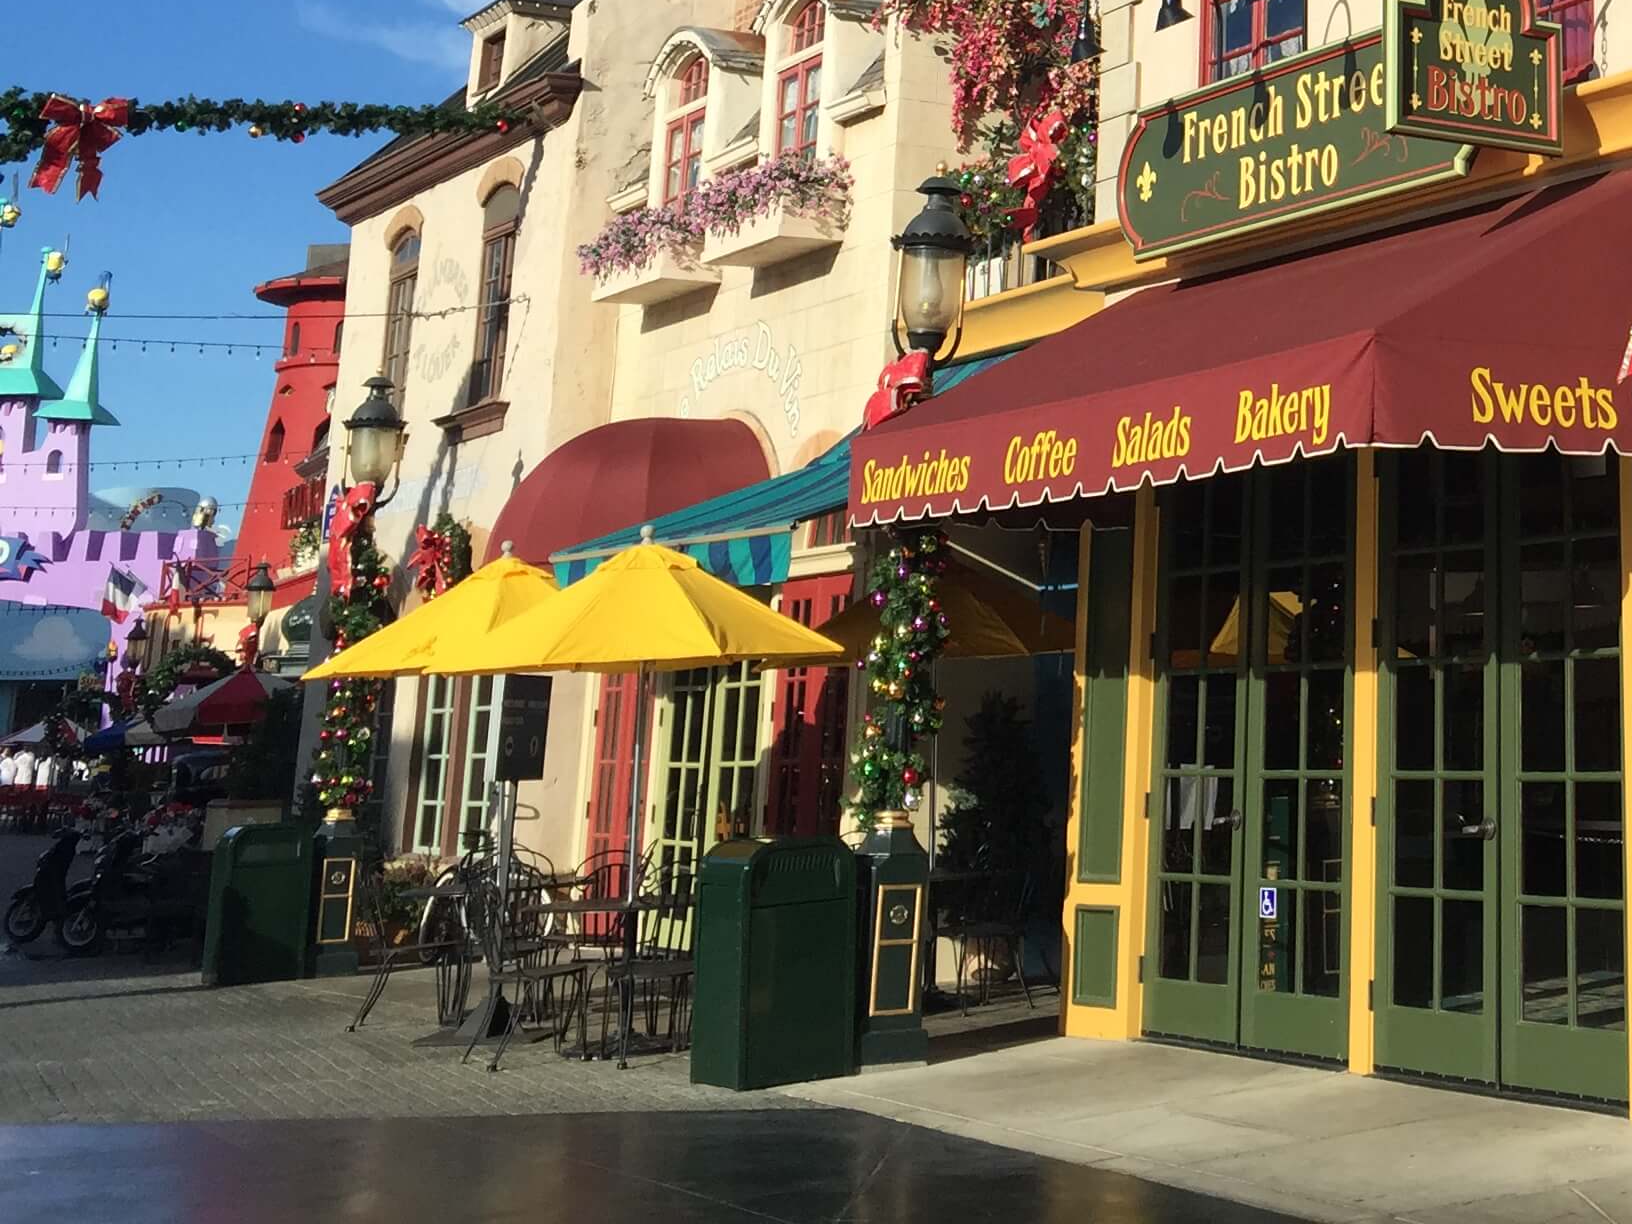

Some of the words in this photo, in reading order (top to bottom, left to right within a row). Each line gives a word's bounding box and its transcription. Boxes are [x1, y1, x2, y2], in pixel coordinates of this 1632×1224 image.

[1439, 28, 1514, 72] Street
[1183, 84, 1284, 164] French
[1296, 62, 1384, 130] Stree
[1426, 65, 1527, 126] Bistro
[1238, 144, 1338, 210] Bistro
[1471, 367, 1618, 430] Sweets
[861, 450, 970, 504] Sandwiches
[1004, 430, 1077, 485] Coffee
[1112, 406, 1191, 468] Salads
[1234, 383, 1331, 446] Bakery
